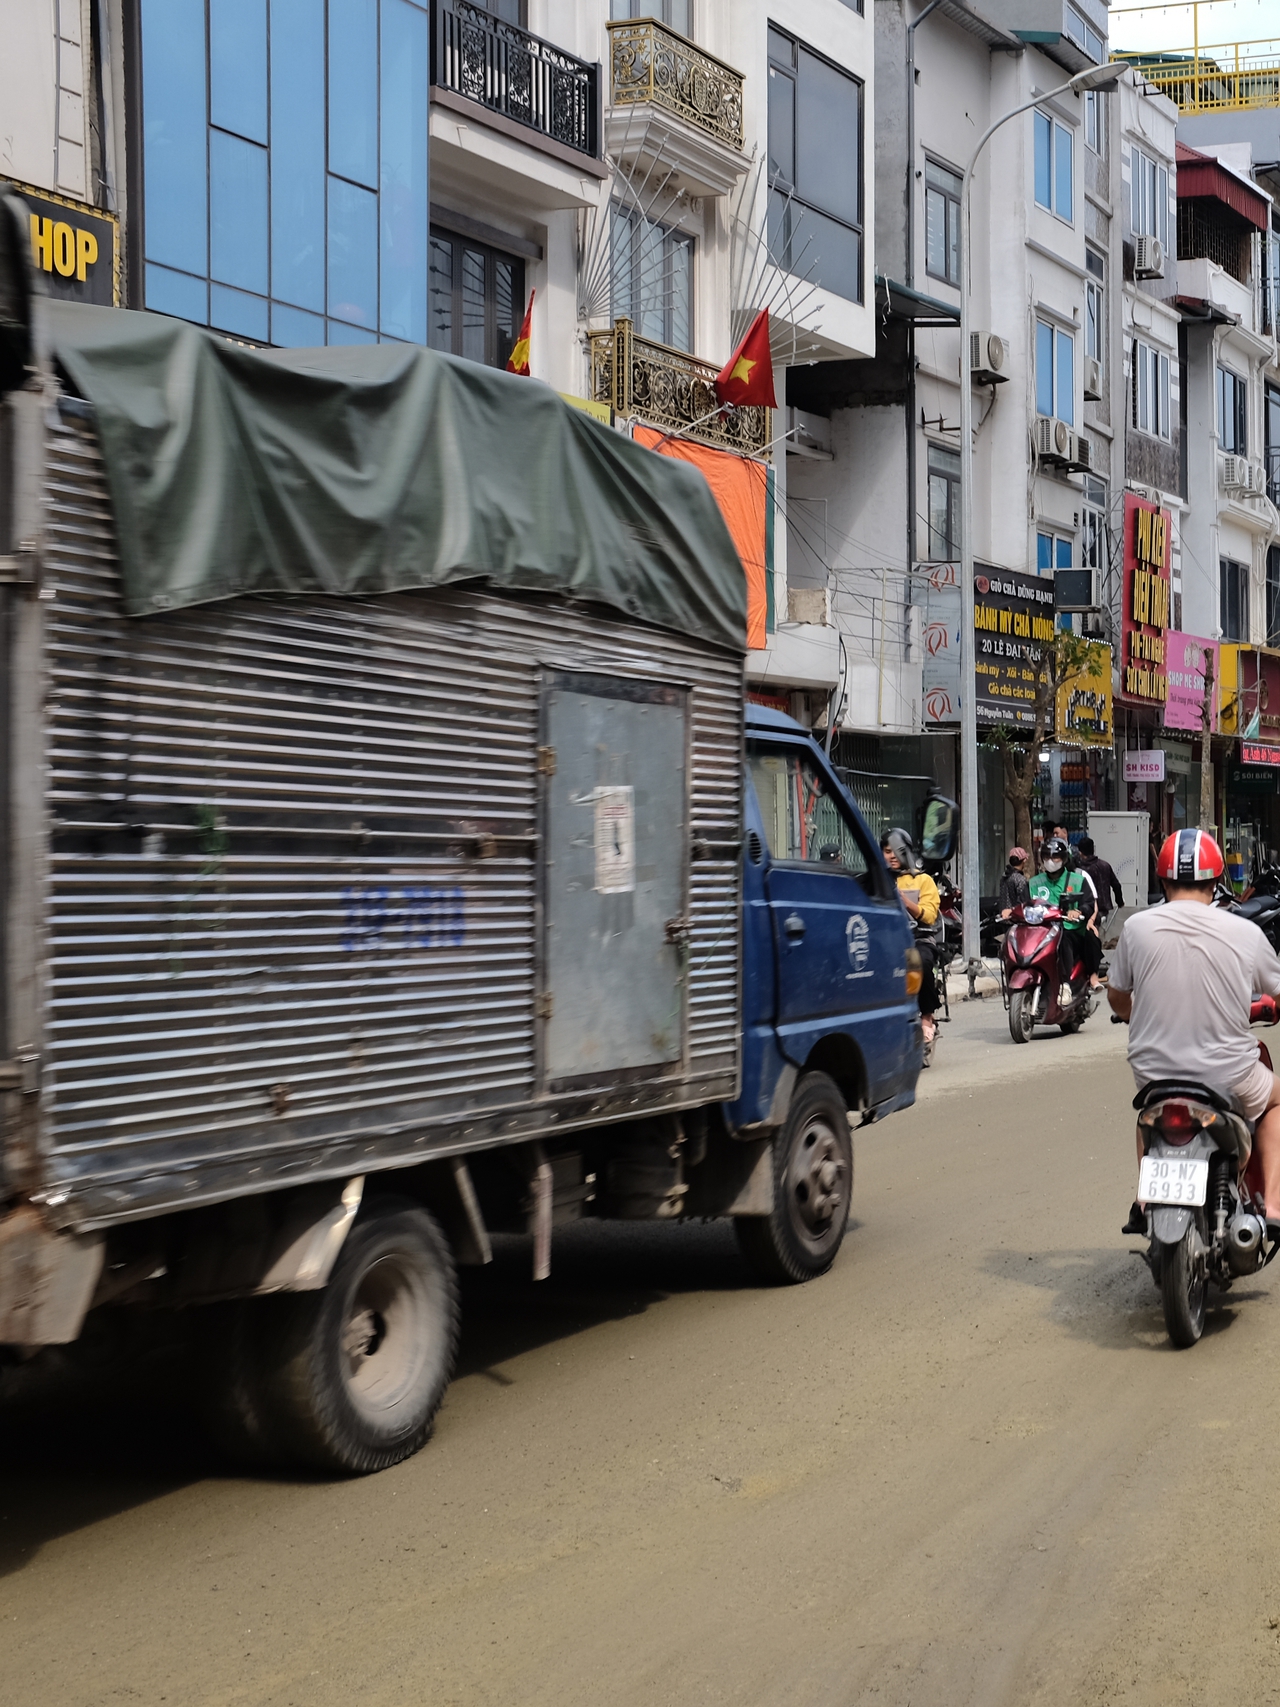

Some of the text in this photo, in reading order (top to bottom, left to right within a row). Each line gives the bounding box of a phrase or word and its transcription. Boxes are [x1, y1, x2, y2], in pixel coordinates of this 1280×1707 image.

[991, 578, 1002, 593] GIÒ
[1003, 580, 1016, 596] CHẢ
[1036, 590, 1053, 605] HẠNH
[975, 601, 998, 632] BÁNH
[1014, 607, 1030, 638] CHẢ
[1033, 612, 1054, 641] NÓNG
[982, 639, 992, 653] 20
[994, 639, 1004, 655] LÊ
[1006, 643, 1020, 660] ĐẠI
[1007, 667, 1017, 679] Xôi
[1169, 671, 1183, 686] SHOP
[988, 682, 999, 695] Giò
[1000, 684, 1012, 697] chả
[1013, 686, 1024, 698] các
[1126, 764, 1137, 772] SH
[1148, 1181, 1196, 1201] 6933
